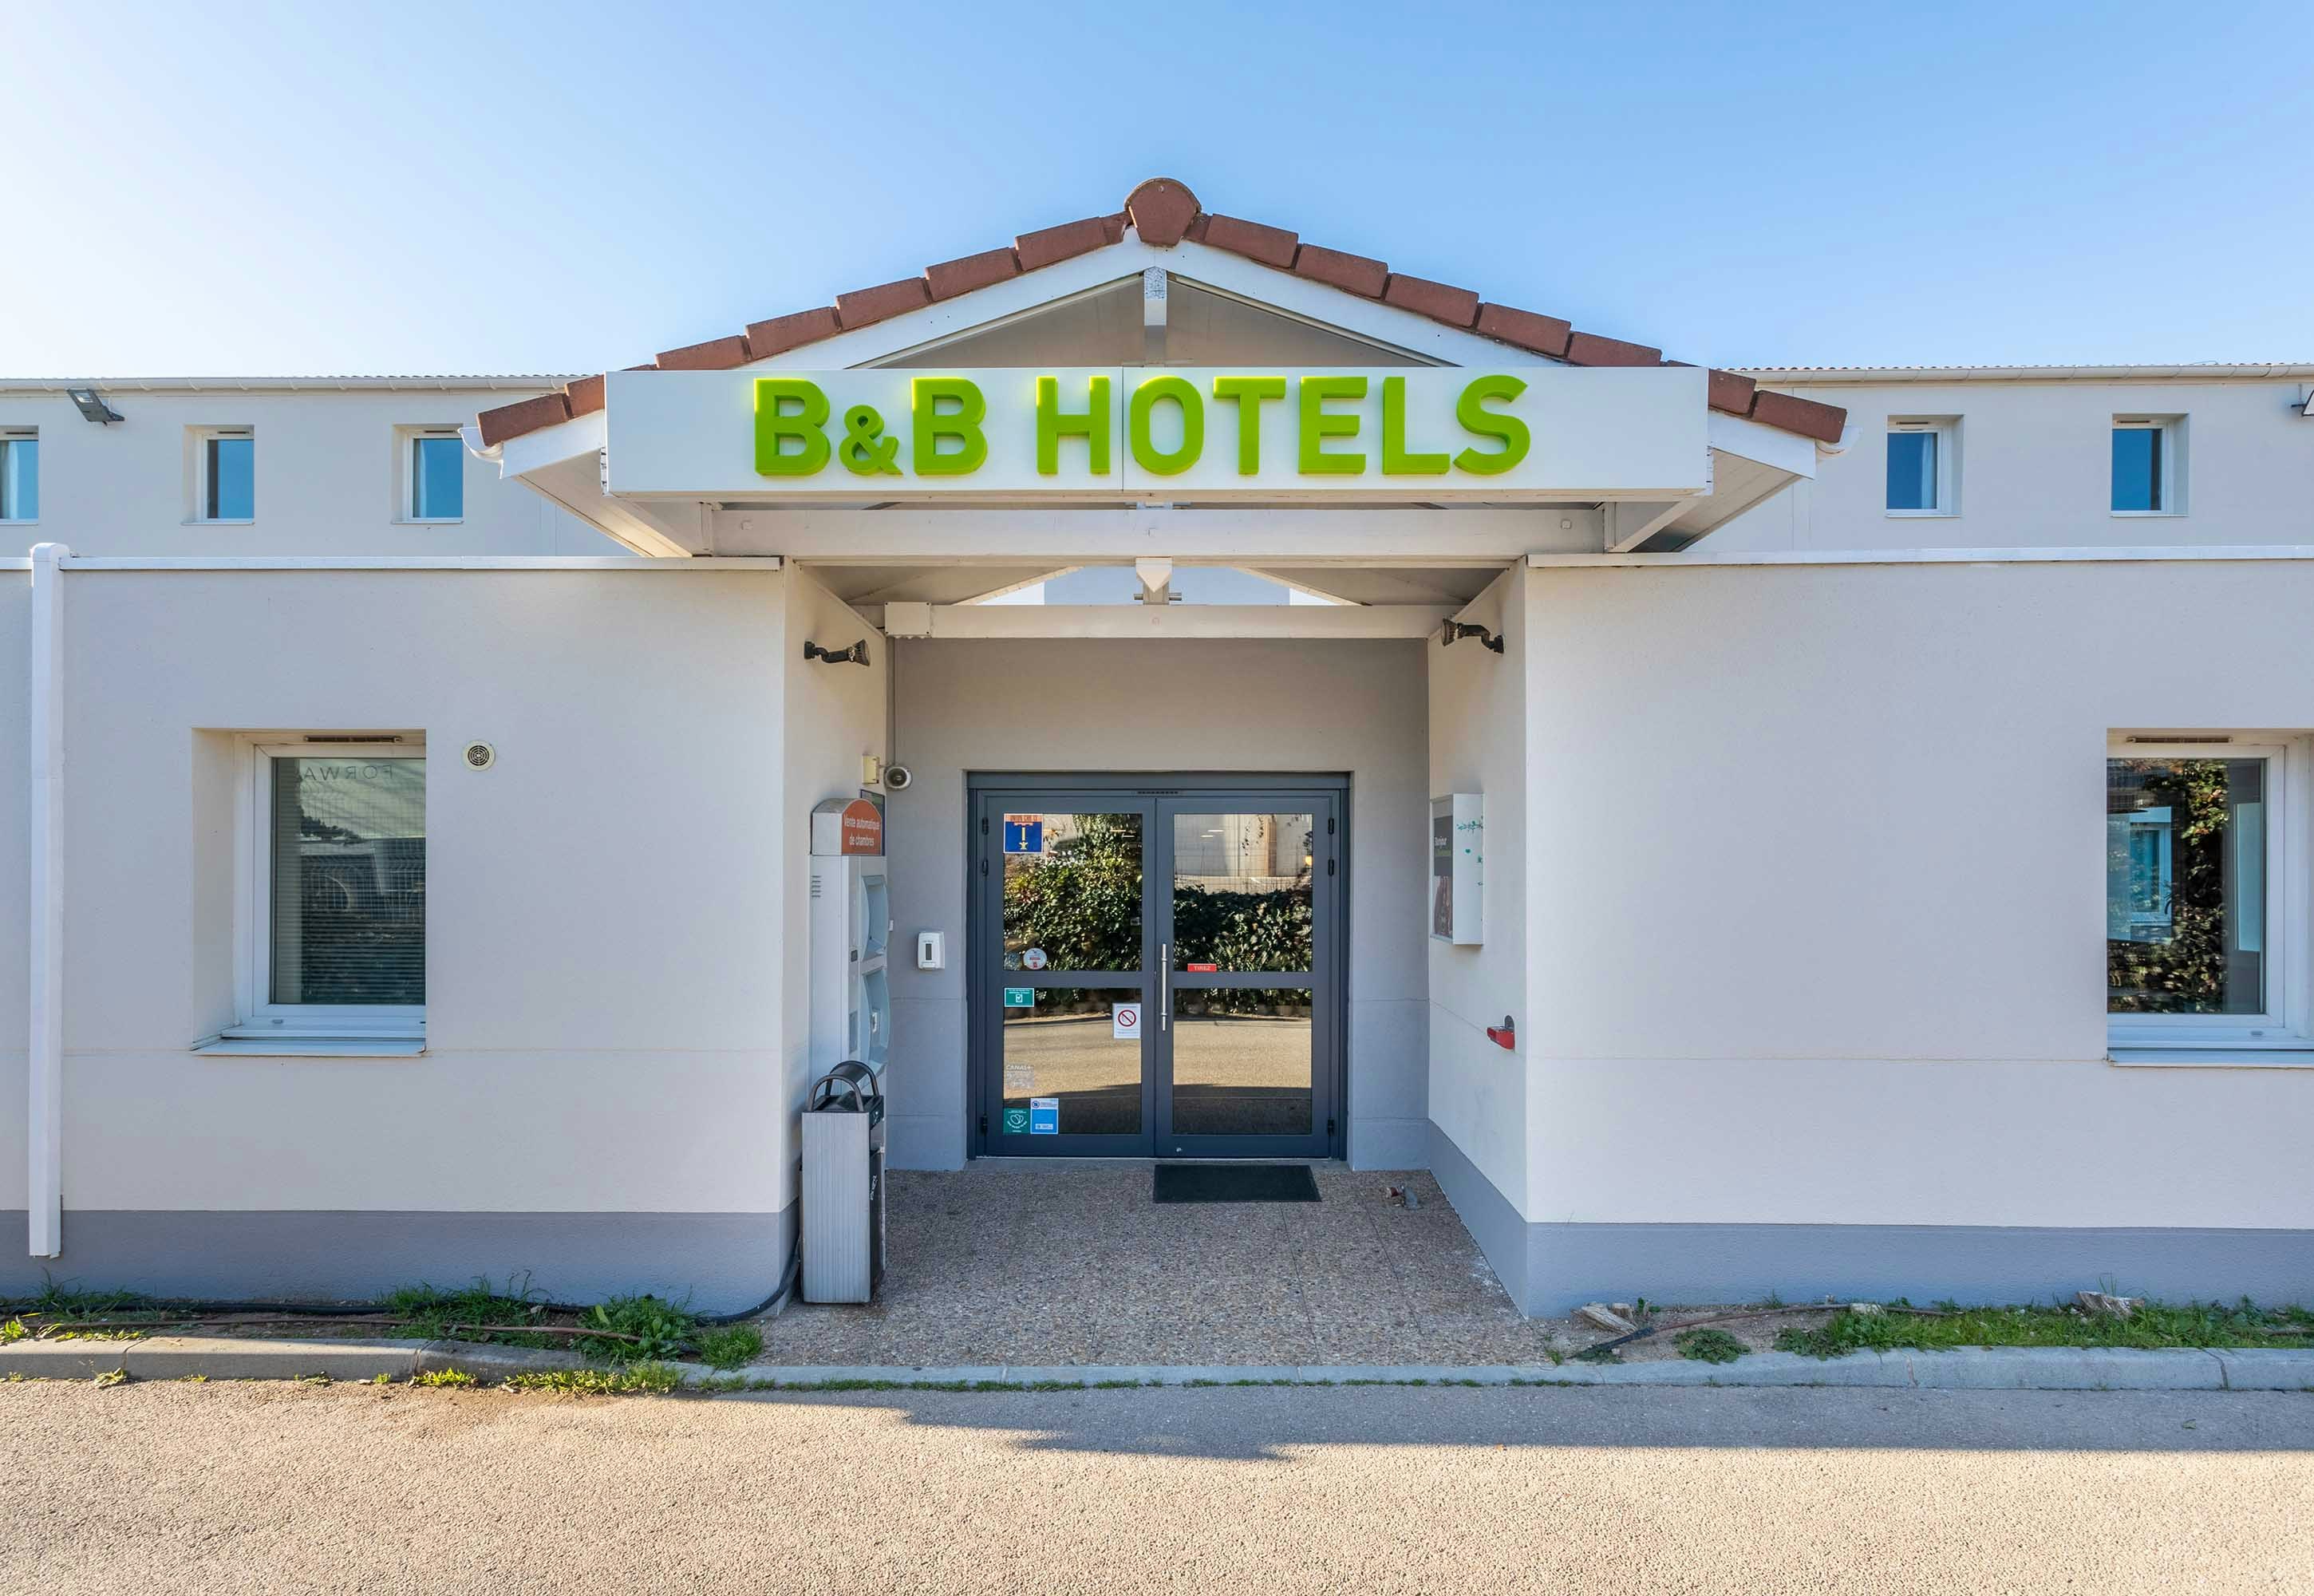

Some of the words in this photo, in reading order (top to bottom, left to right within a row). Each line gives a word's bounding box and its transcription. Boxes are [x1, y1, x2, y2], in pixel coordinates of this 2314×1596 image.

[754, 377, 989, 477] B&B
[1036, 375, 1531, 476] HOTELS
[843, 813, 856, 828] Vente
[856, 818, 880, 832] automatique
[849, 832, 855, 846] de
[855, 835, 875, 847] chambres
